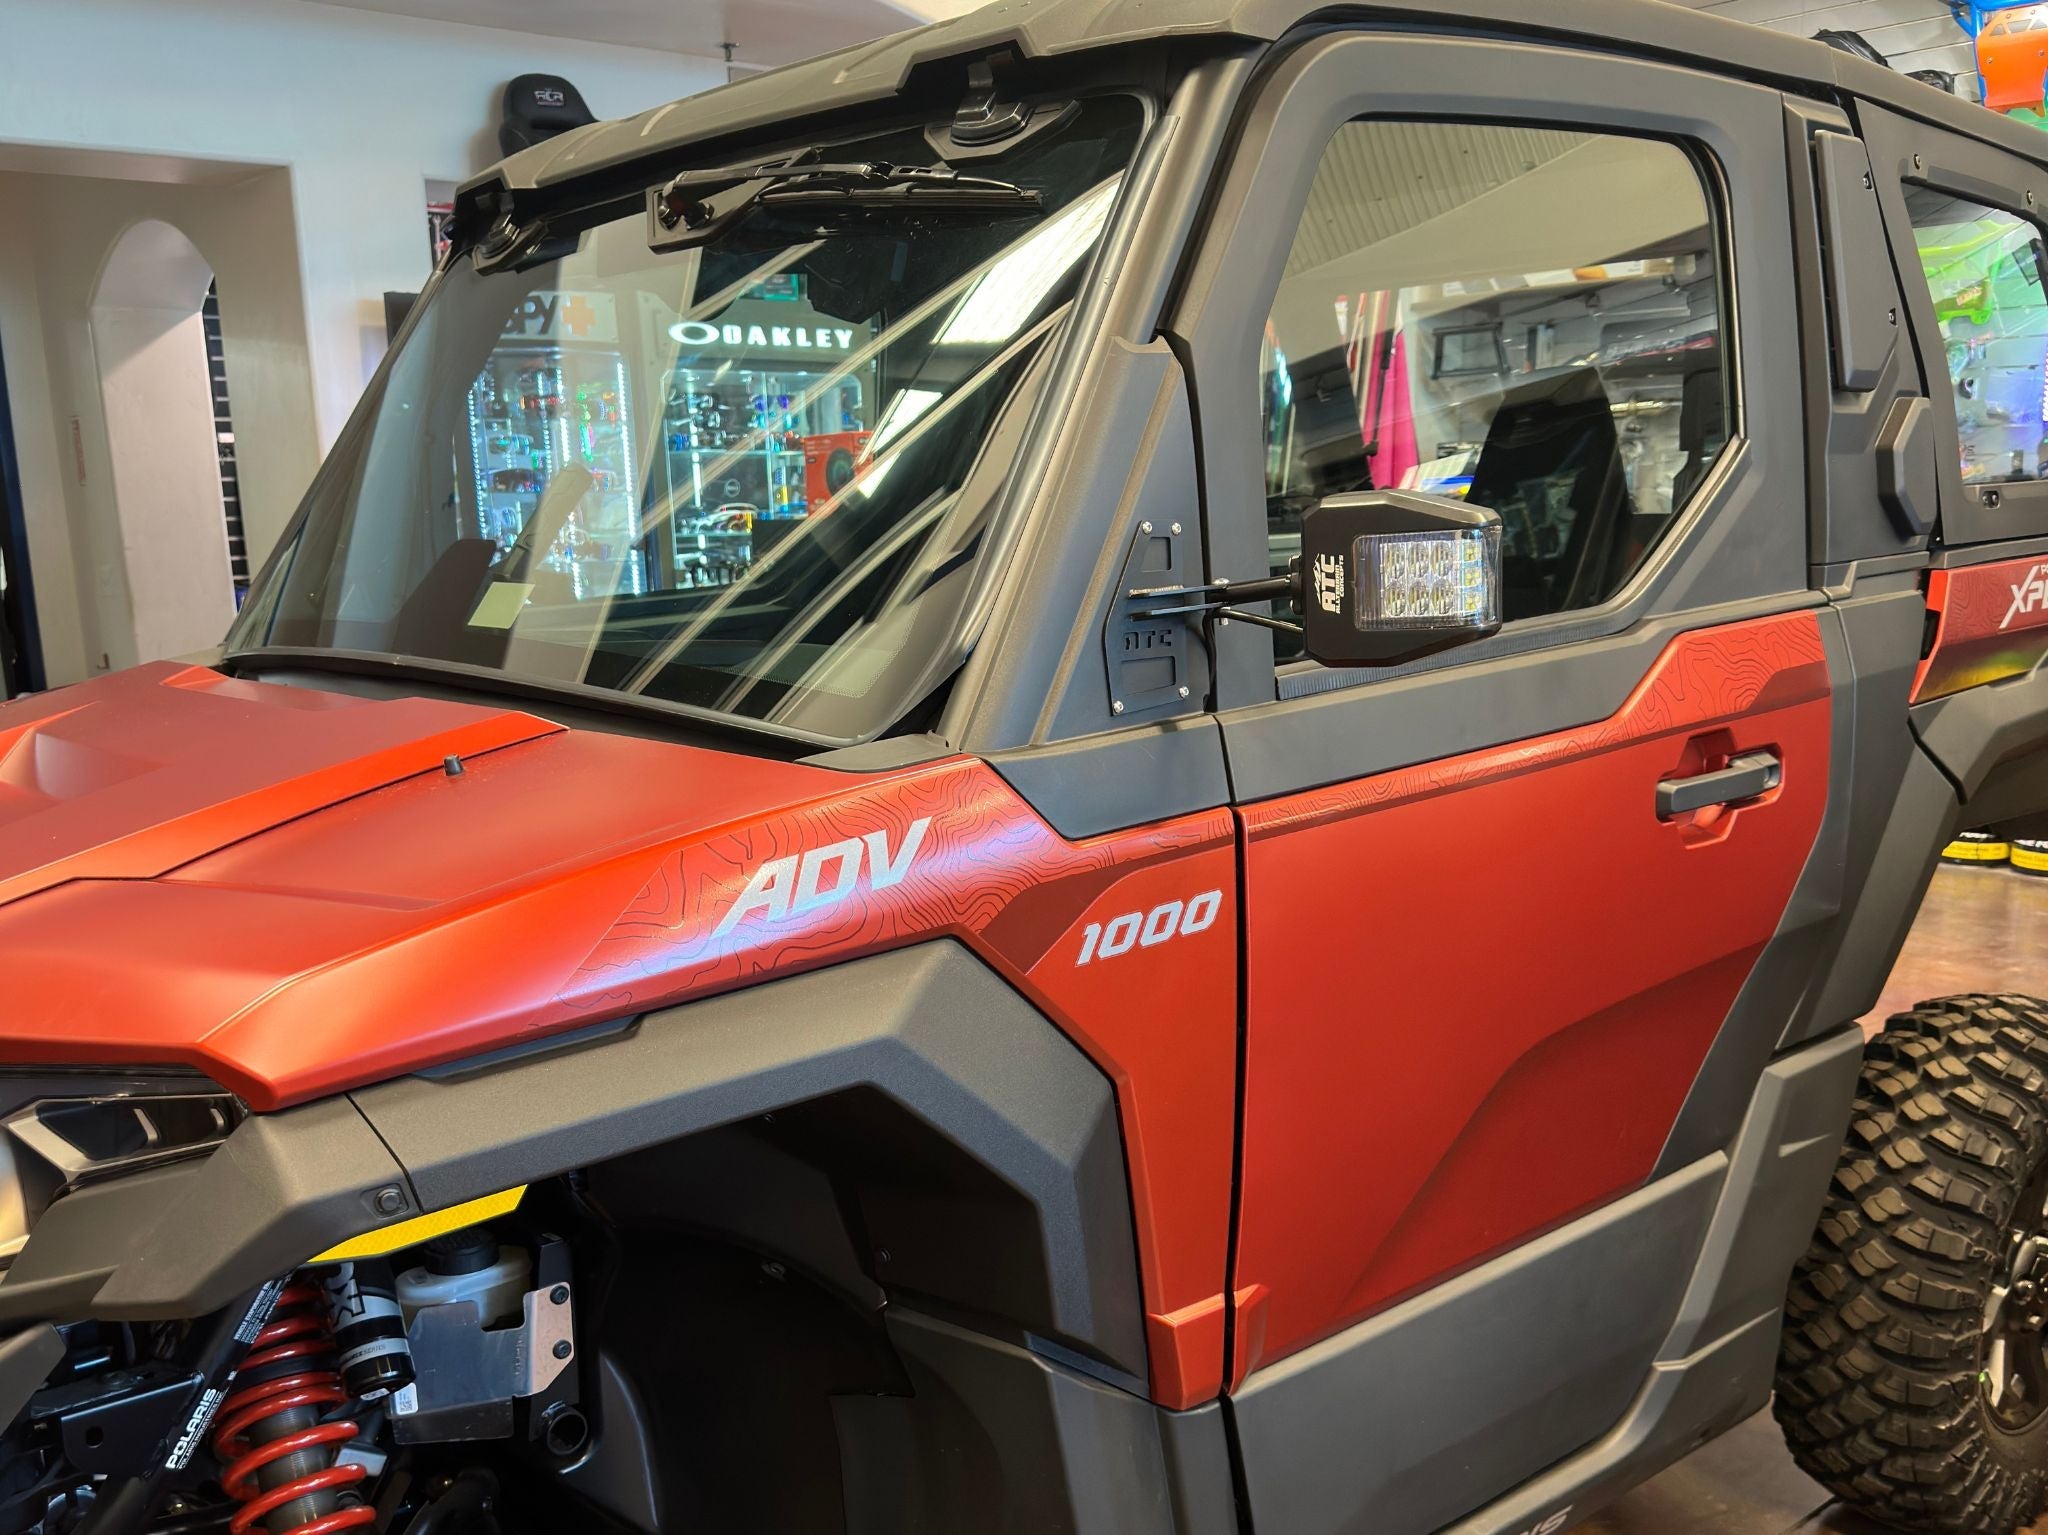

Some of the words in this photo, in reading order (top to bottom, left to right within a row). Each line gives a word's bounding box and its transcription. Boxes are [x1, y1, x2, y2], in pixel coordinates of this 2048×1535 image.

[722, 325, 854, 349] OAKLEY
[1320, 553, 1336, 613] ATC
[711, 817, 932, 940] ADV
[1074, 889, 1224, 968] 1000
[165, 1387, 217, 1471] POLARIS
